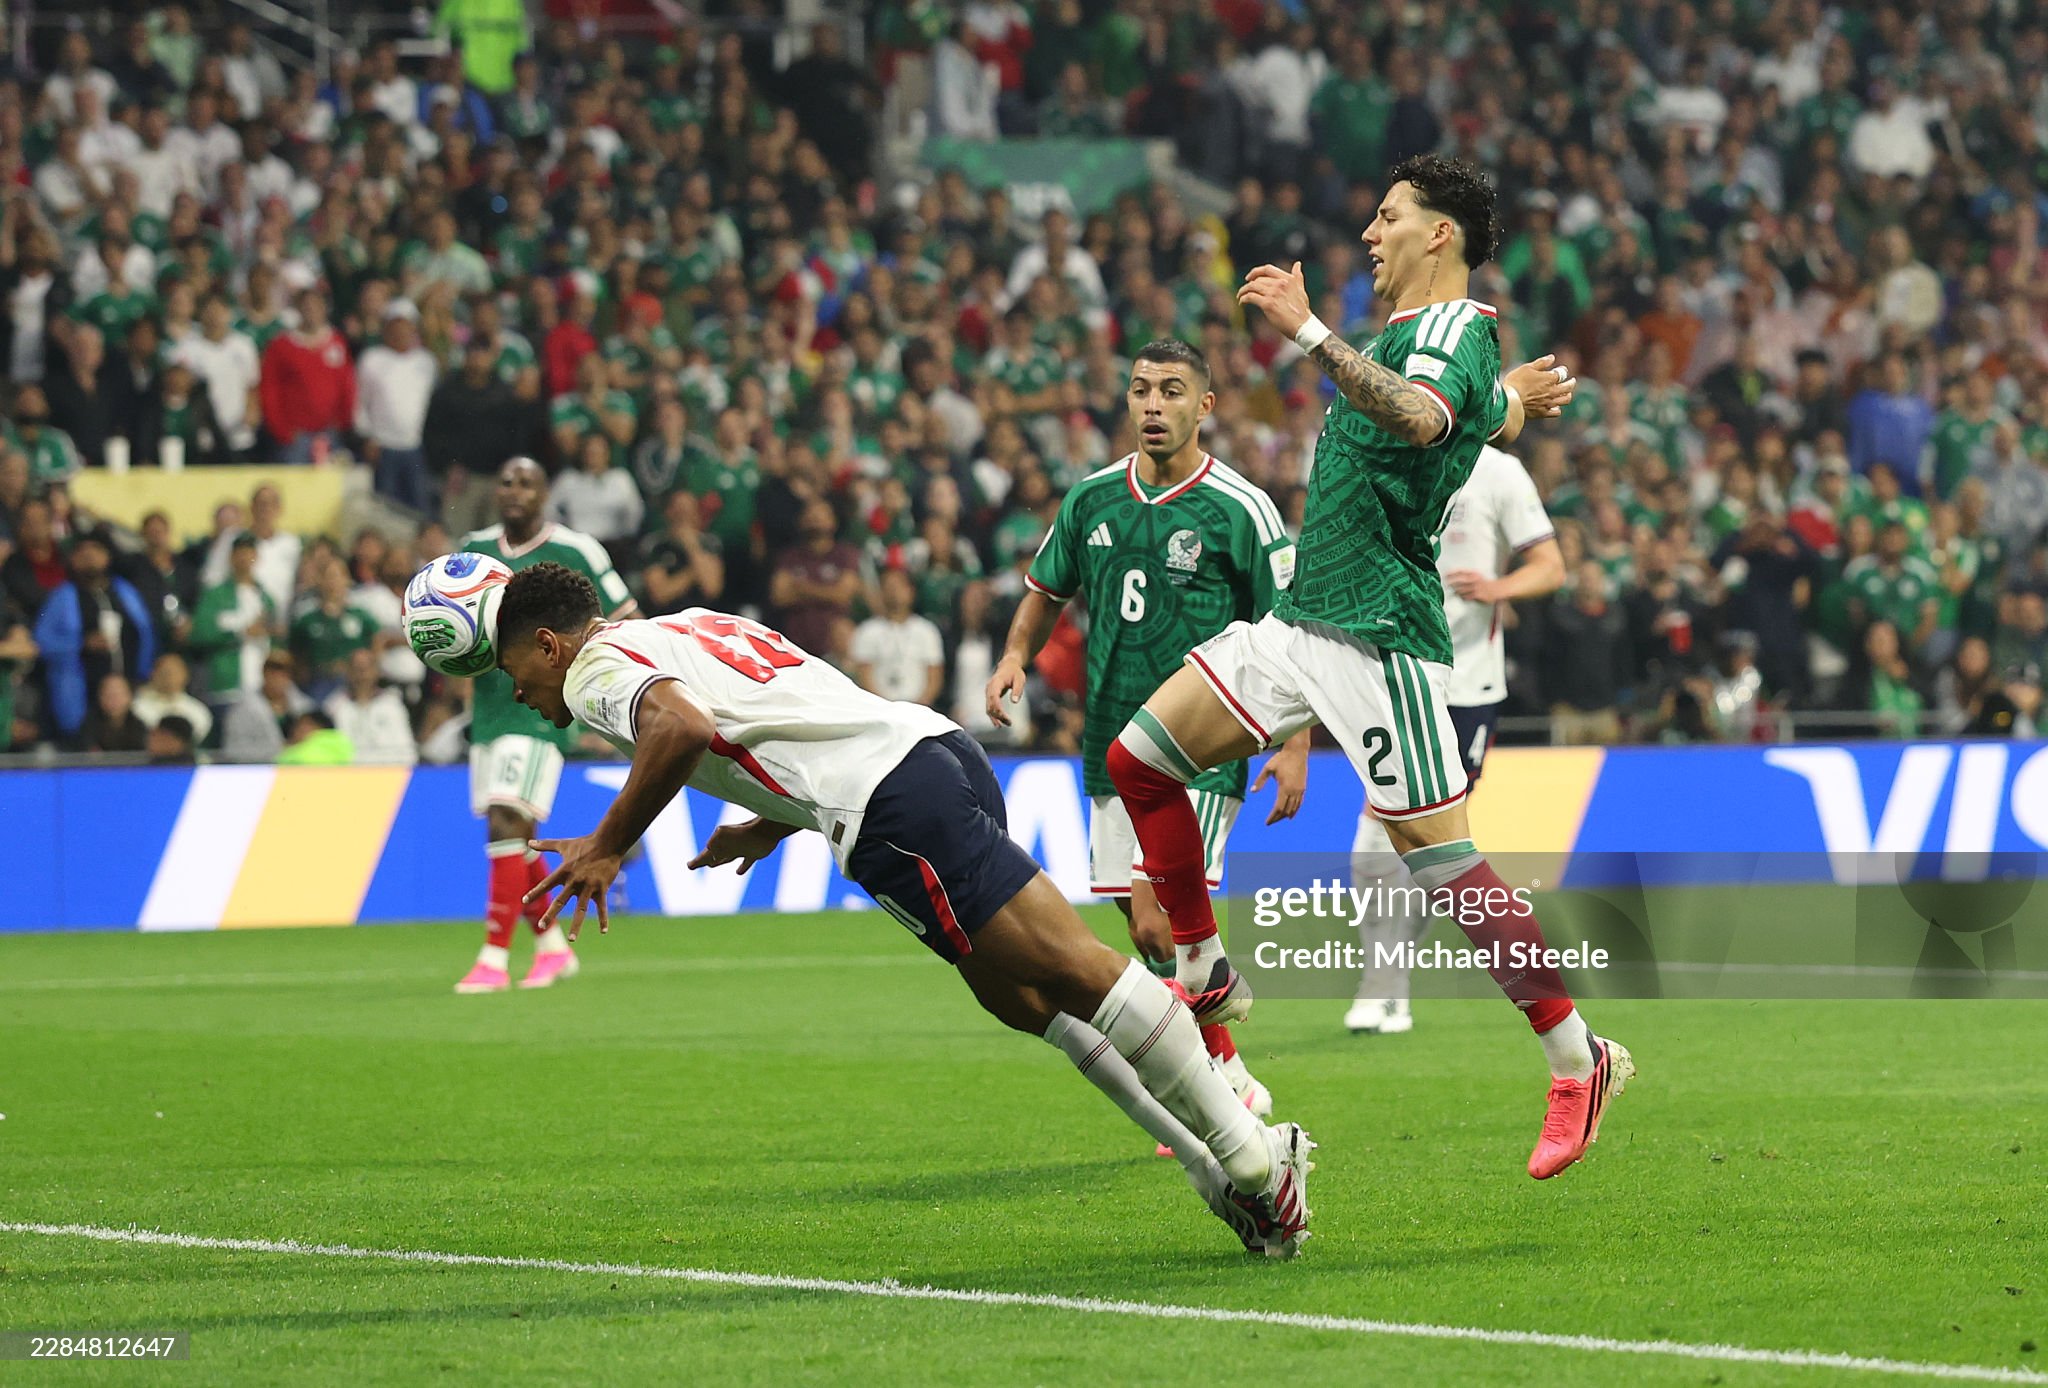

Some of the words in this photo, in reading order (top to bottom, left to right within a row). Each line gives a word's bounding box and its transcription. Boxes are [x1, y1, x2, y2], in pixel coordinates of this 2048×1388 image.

[1120, 569, 1148, 622] 6
[1362, 727, 1397, 786] 2
[1468, 723, 1488, 767] 4
